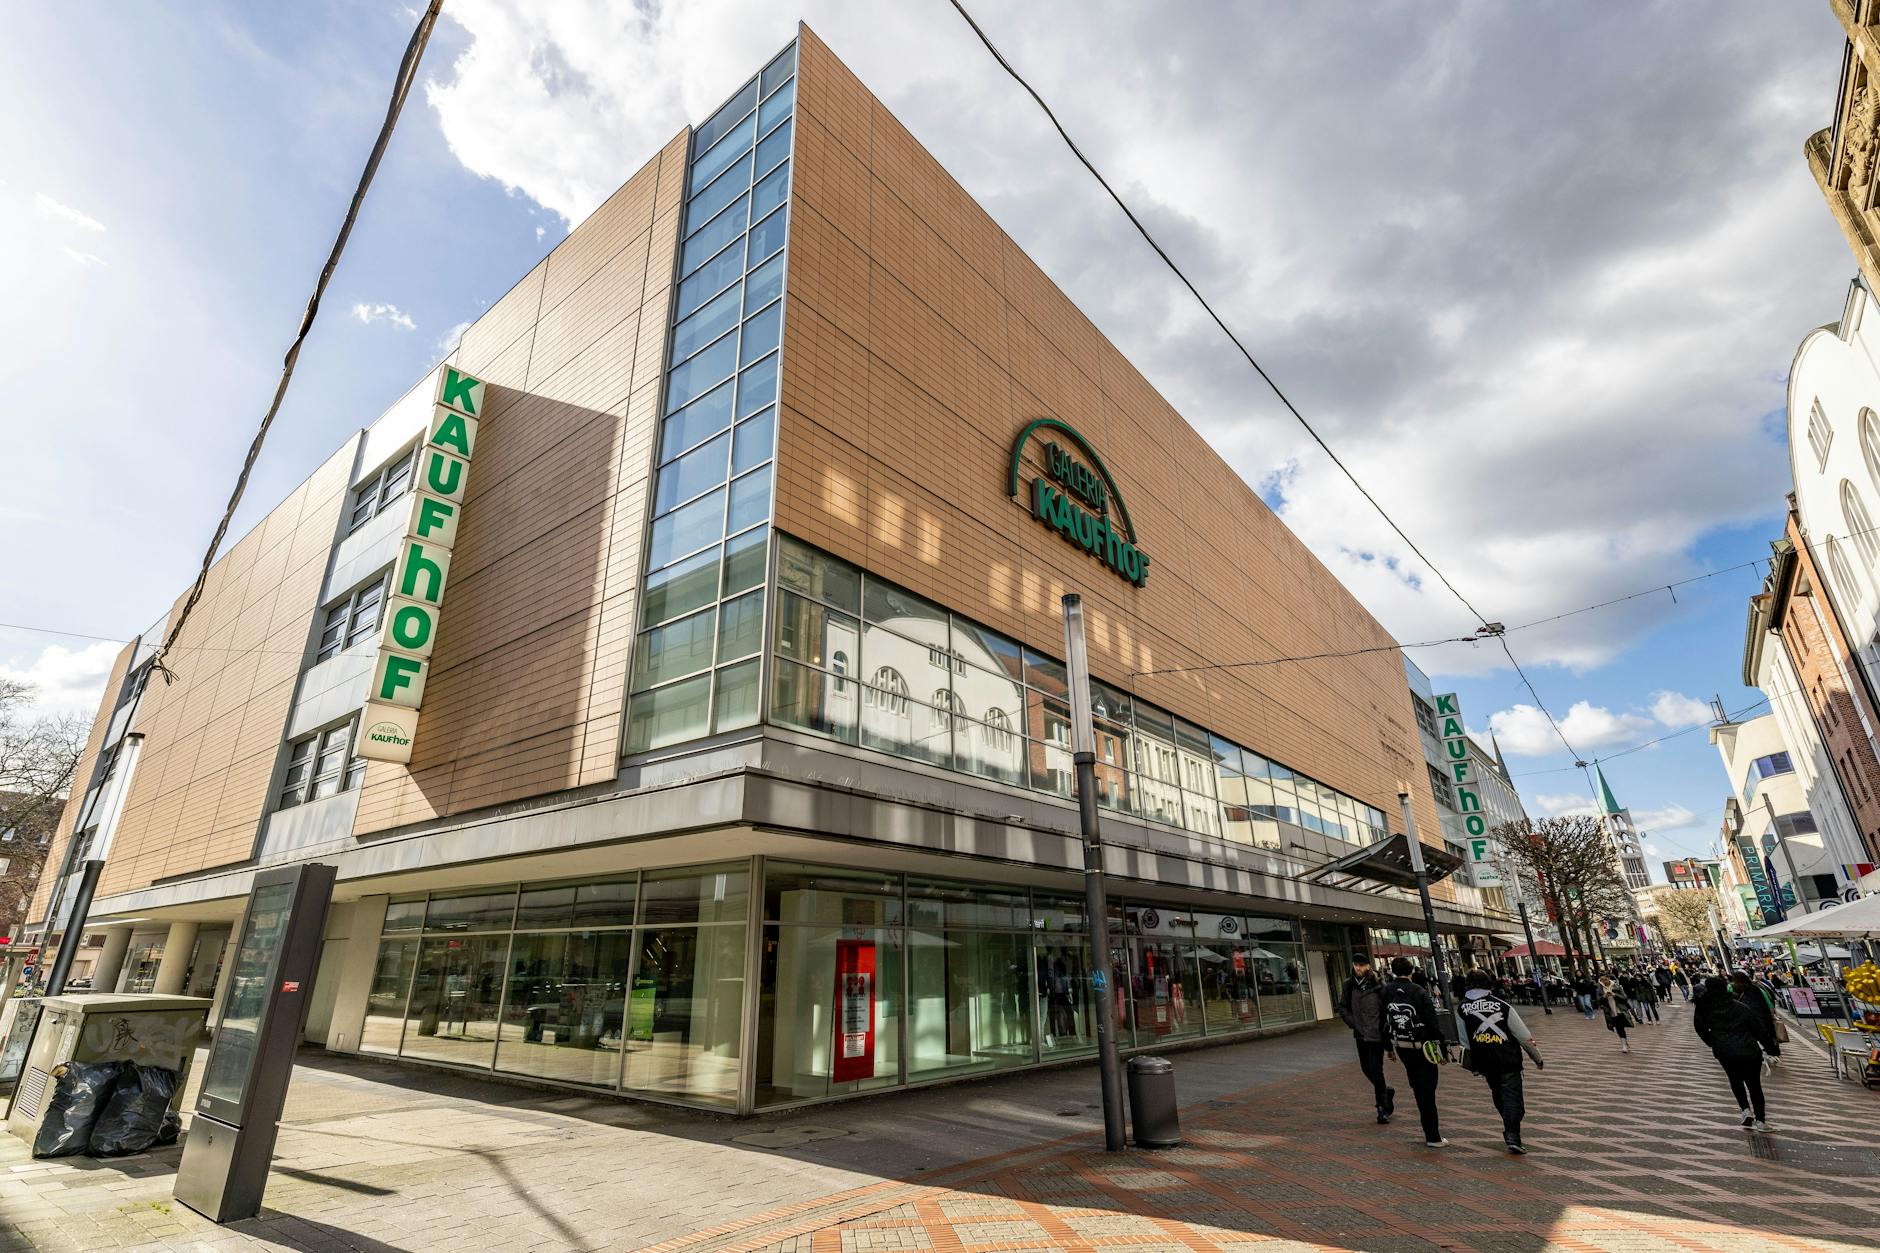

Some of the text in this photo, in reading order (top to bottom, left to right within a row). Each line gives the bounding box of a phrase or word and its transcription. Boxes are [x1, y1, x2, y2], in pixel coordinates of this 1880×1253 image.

[1046, 441, 1109, 514] GALERIA
[1742, 846, 1776, 913] PRIMARK
[1475, 1033, 1503, 1044] URBAN
